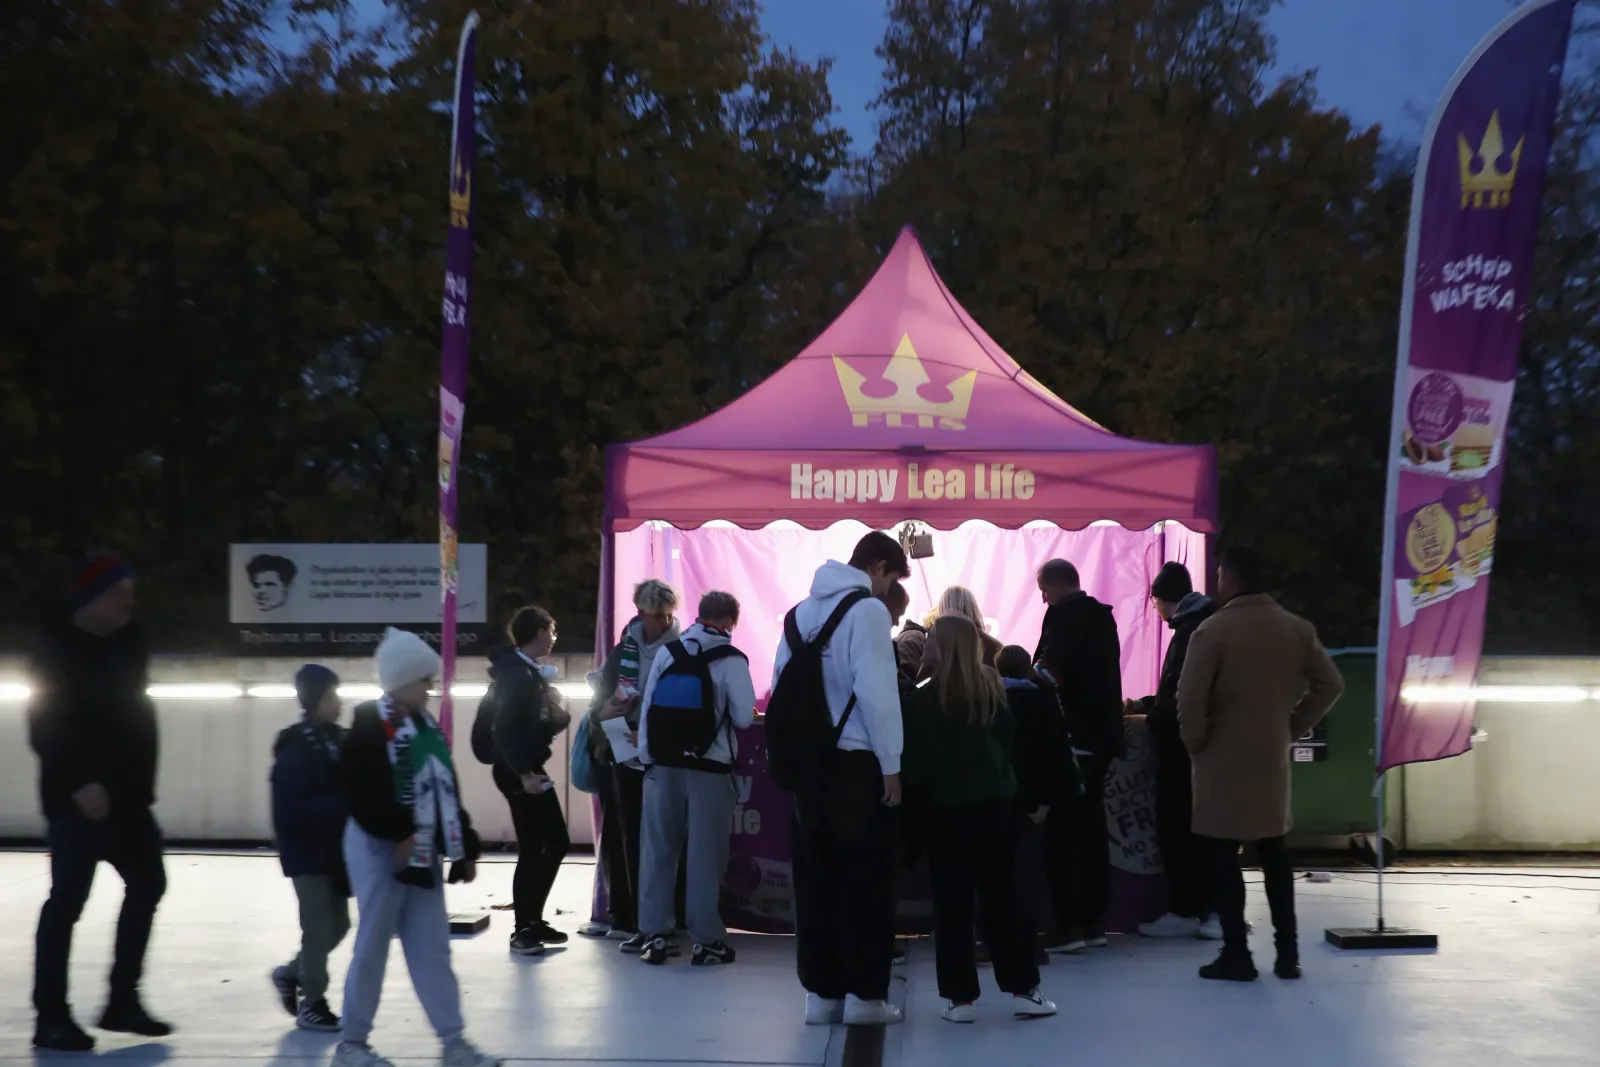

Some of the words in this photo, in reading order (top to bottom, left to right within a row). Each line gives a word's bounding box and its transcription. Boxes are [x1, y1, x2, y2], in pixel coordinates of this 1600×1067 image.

[790, 463, 898, 503] Happy
[908, 463, 966, 500] Lea
[975, 463, 1036, 500] Life
[1103, 769, 1149, 798] GLUT
